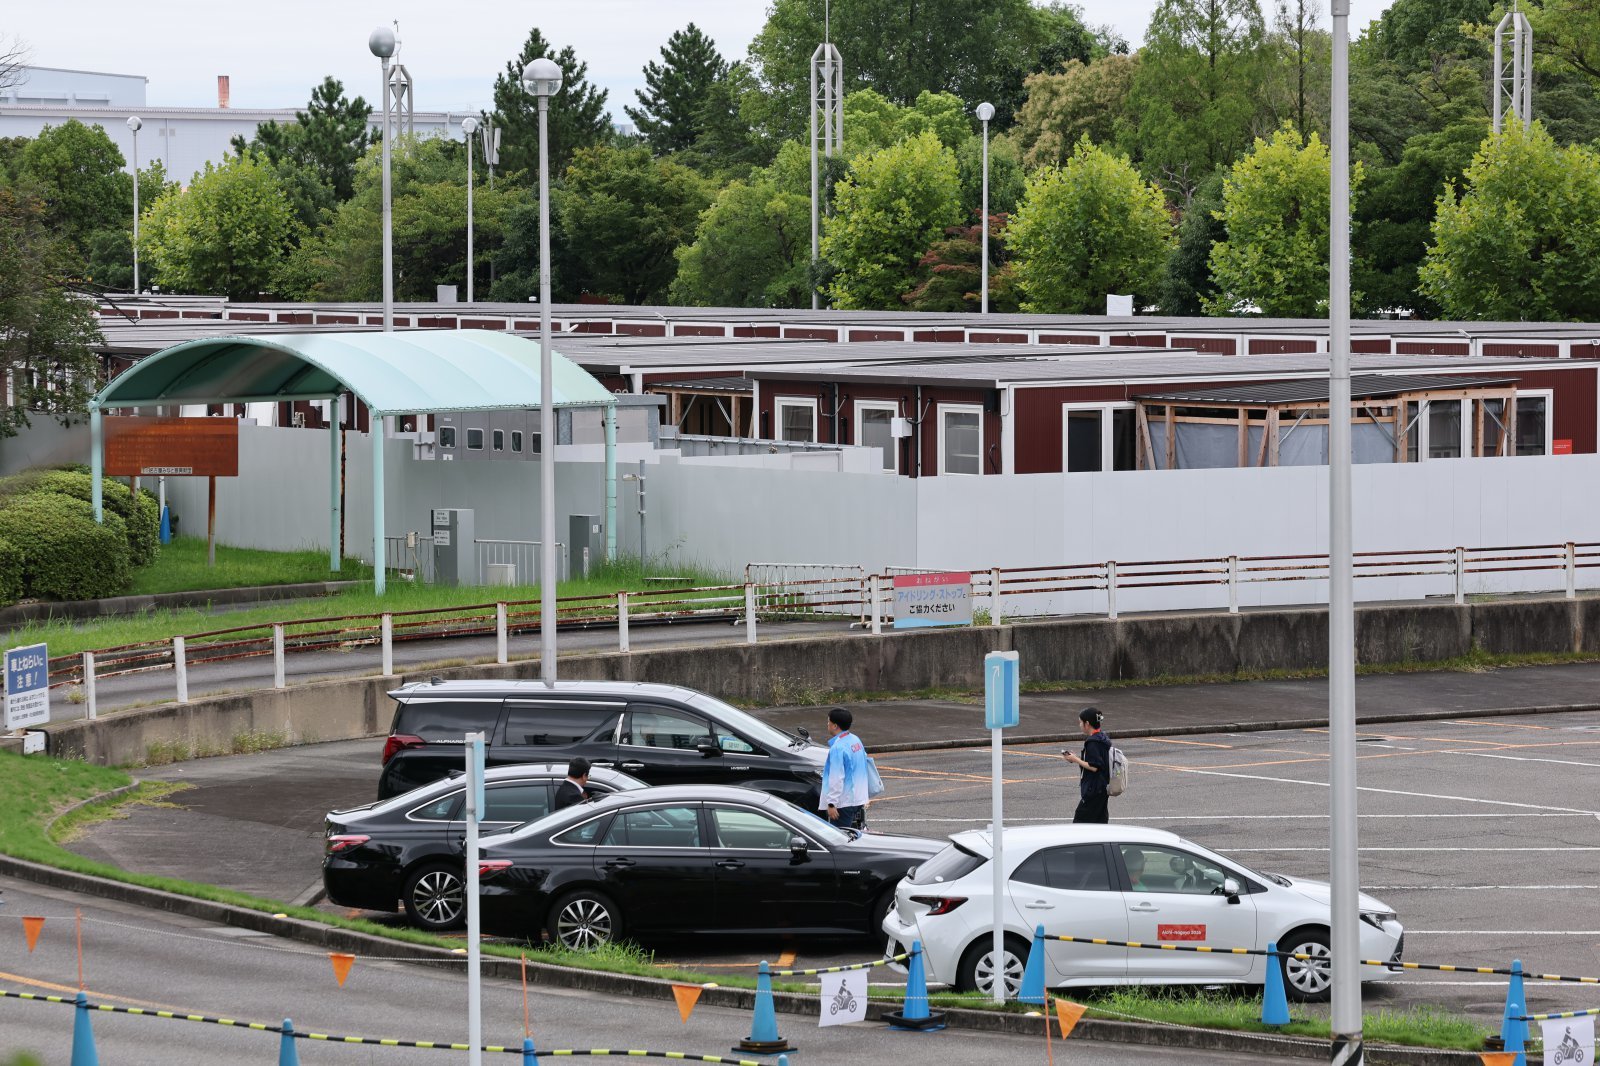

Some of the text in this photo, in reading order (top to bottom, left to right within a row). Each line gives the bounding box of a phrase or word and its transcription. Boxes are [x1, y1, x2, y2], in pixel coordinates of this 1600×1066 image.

[909, 603, 955, 614] ご協力ください
